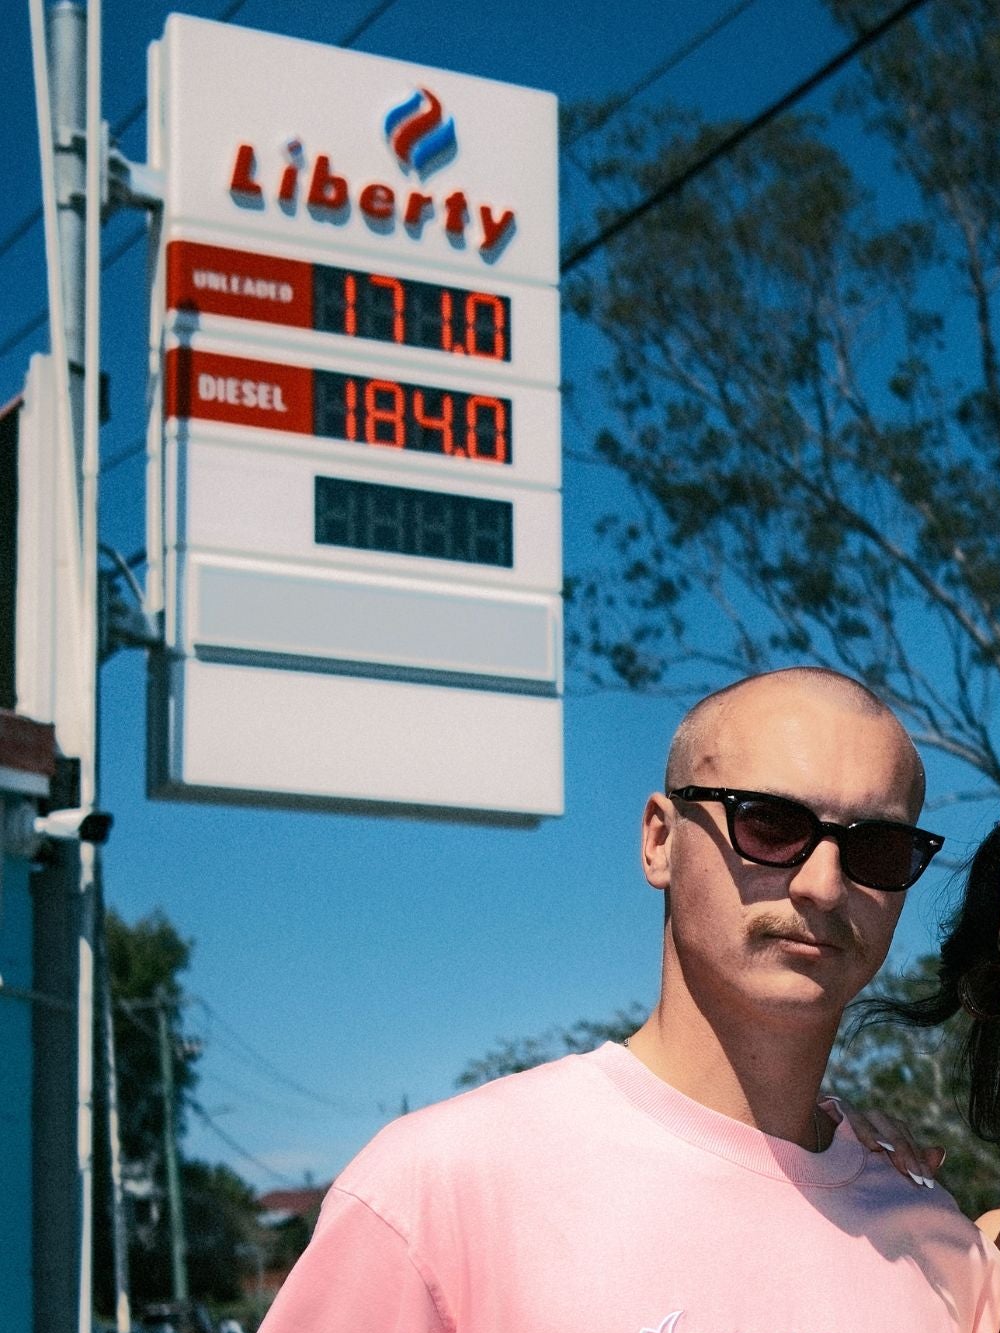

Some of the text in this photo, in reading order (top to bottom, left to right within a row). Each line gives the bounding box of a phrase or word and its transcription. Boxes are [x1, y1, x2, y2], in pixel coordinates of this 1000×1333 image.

[229, 139, 515, 257] Liberty
[192, 269, 505, 361] UNLEADED 171.0
[197, 373, 505, 464] DIESEL 184.0
